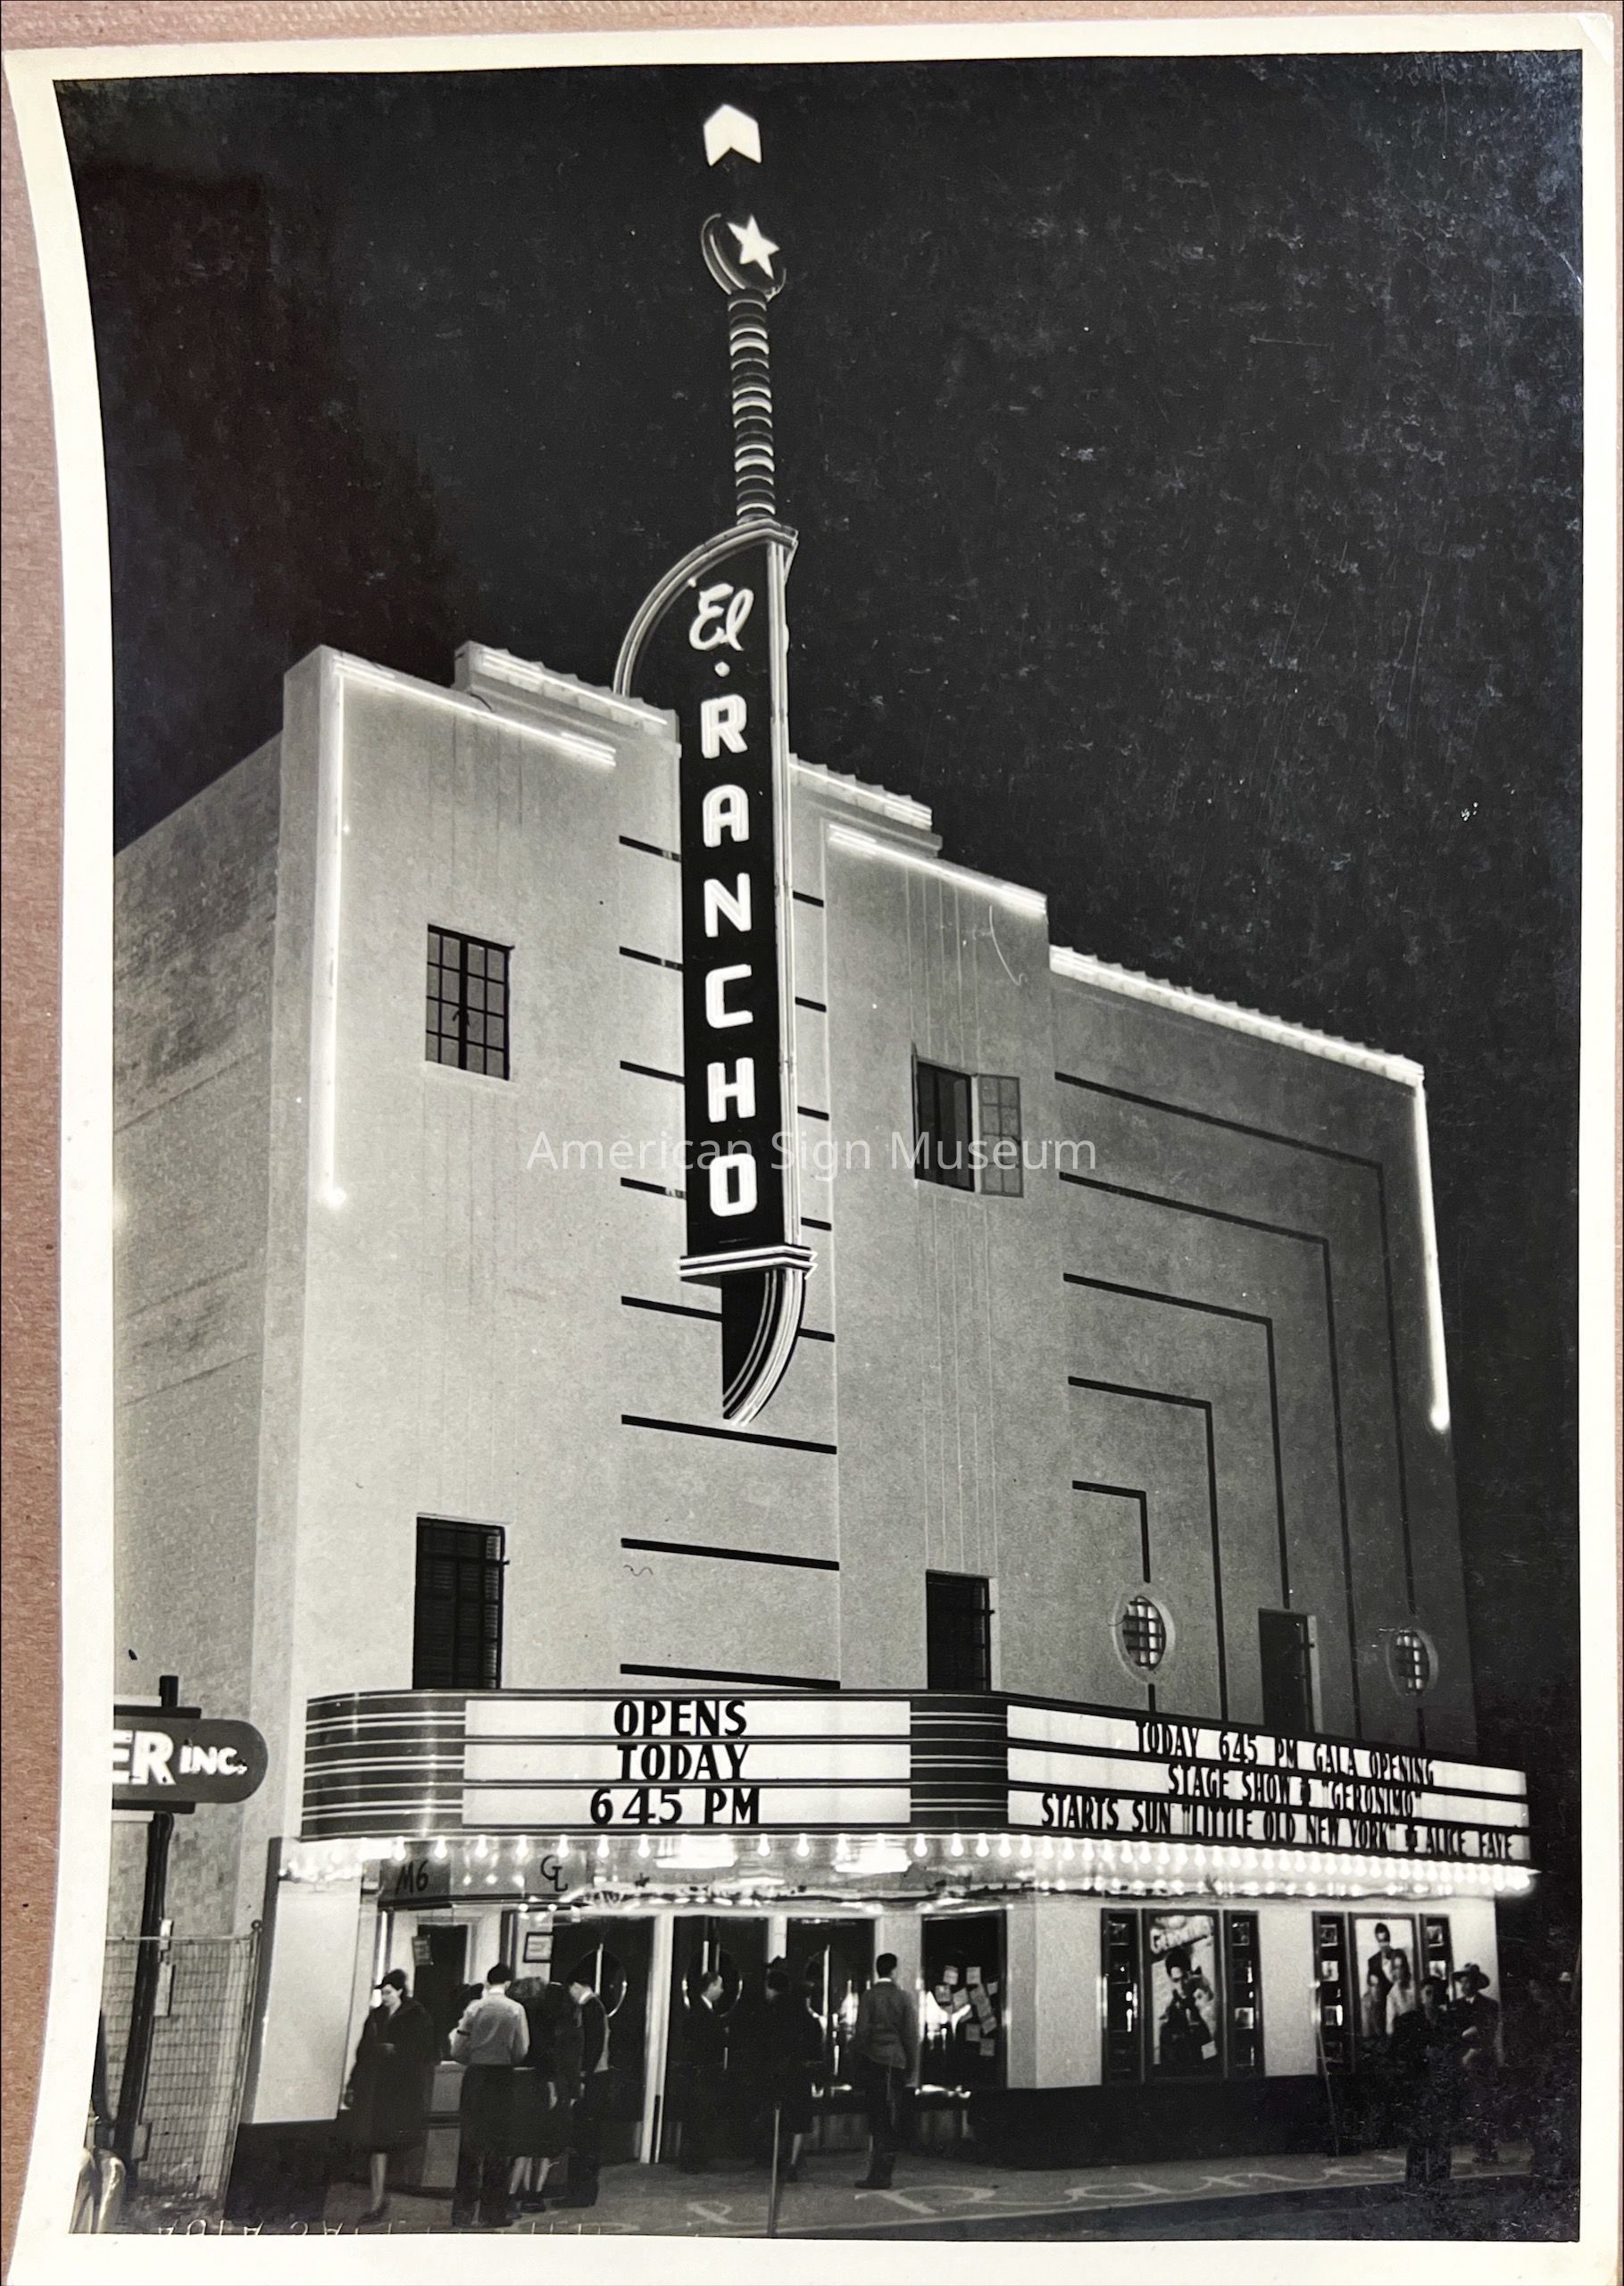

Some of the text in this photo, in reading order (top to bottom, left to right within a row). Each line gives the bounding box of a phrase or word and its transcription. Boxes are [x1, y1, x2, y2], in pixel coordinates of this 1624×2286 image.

[688, 582, 754, 652] El
[700, 694, 757, 1216] RANCHO
[614, 1700, 747, 1737] OPENS
[179, 1746, 248, 1776] INC.
[617, 1744, 750, 1781] TODAY
[1136, 1717, 1435, 1787] TODAY 645 PM GALA OPENING
[590, 1788, 759, 1824] 645 PM
[1168, 1763, 1229, 1800] STAGE
[1242, 1772, 1290, 1806] SHOW
[1042, 1791, 1119, 1831] STARTS
[1132, 1799, 1170, 1835] SUN
[1263, 1809, 1296, 1844] OLD
[1305, 1814, 1338, 1848] NEW
[1426, 1825, 1467, 1859] ALICE
[1478, 1829, 1513, 1863] FAYE
